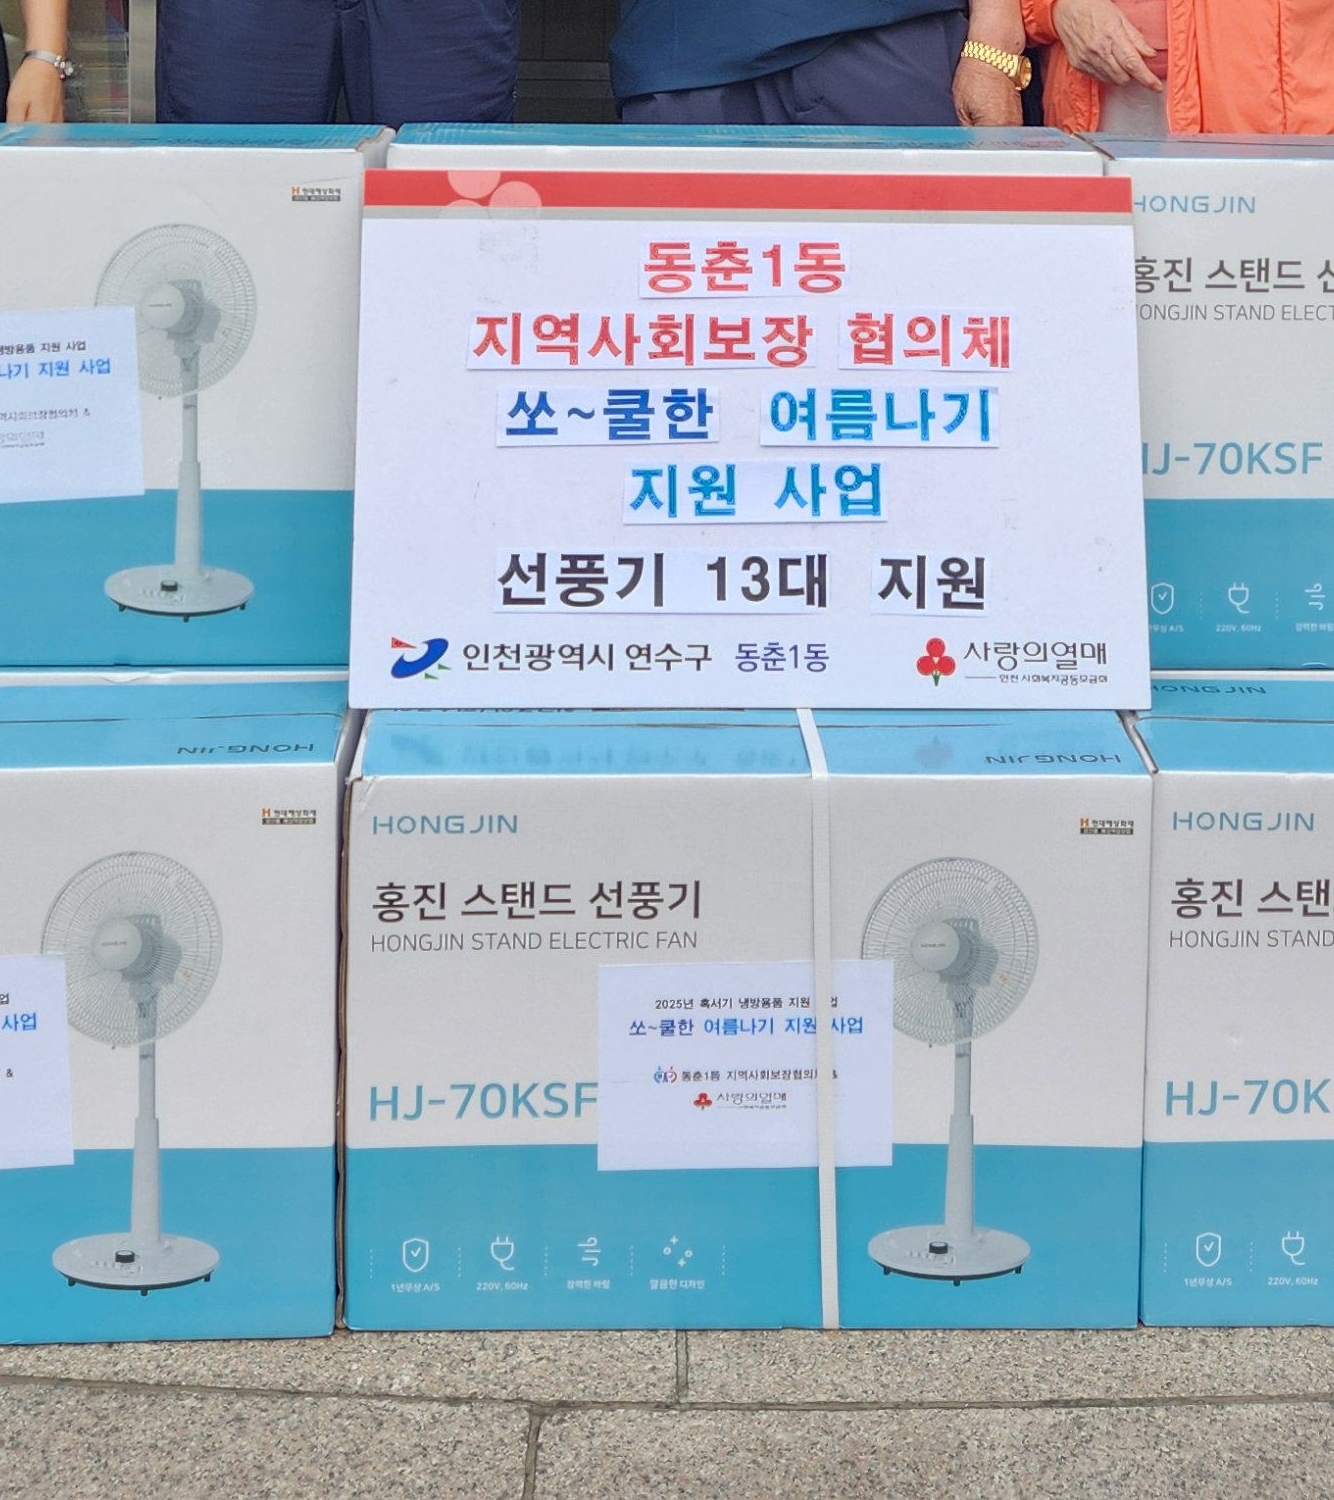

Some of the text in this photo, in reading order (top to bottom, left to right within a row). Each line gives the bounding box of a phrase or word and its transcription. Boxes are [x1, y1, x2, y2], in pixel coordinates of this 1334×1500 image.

[644, 241, 846, 294] 동춘1동
[1205, 258, 1305, 292] 스탠드
[472, 312, 1010, 368] 지역사회보장 협의체
[505, 387, 989, 441] 쏘~쿨한 여름나기
[630, 464, 880, 518] 지원 사업
[498, 553, 984, 610] 선풍기 13대 지원
[463, 643, 829, 672] 인천광역시 연수구 동춘1동
[963, 641, 1107, 671] 사랑의열매
[373, 881, 699, 922] 홍진 스탠드 선풍기
[1172, 878, 1242, 918] 홍진
[2, 1013, 36, 1031] 사업
